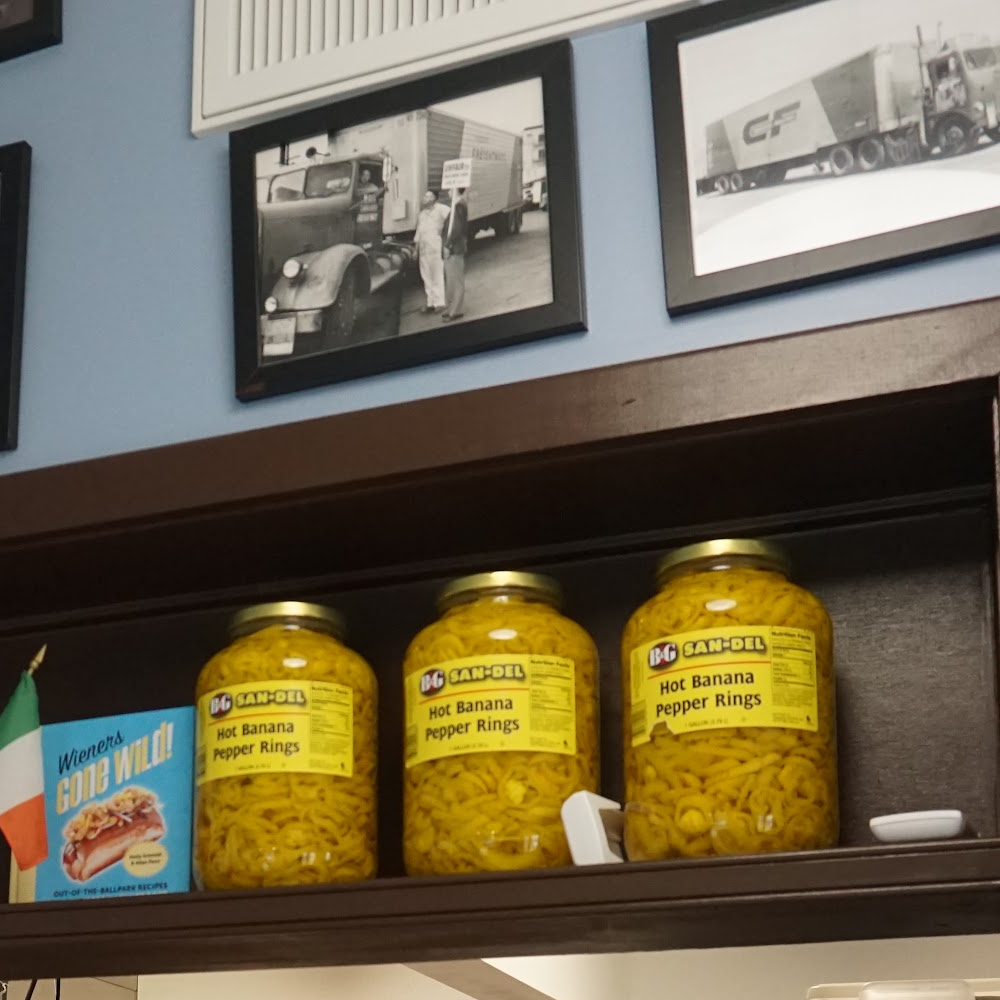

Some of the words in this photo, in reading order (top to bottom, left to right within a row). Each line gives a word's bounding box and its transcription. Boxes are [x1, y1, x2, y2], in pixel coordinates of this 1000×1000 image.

[743, 101, 801, 145] CF
[683, 635, 768, 658] SAN-DEL
[449, 663, 527, 685] SAN-DEL
[660, 677, 687, 696] Hot
[692, 671, 755, 690] Banana
[236, 689, 307, 708] SAN-DEL
[428, 704, 451, 721] Hot
[456, 697, 514, 714] Banana
[655, 695, 709, 718] Pepper
[714, 690, 762, 710] Rings
[217, 726, 238, 741] Hot
[242, 722, 295, 736] Banana
[425, 721, 471, 742] Pepper
[477, 715, 520, 735] Rings
[58, 730, 125, 775] Wieners
[213, 743, 256, 762] Pepper
[260, 738, 300, 756] Rings
[137, 881, 169, 892] RECIPES
